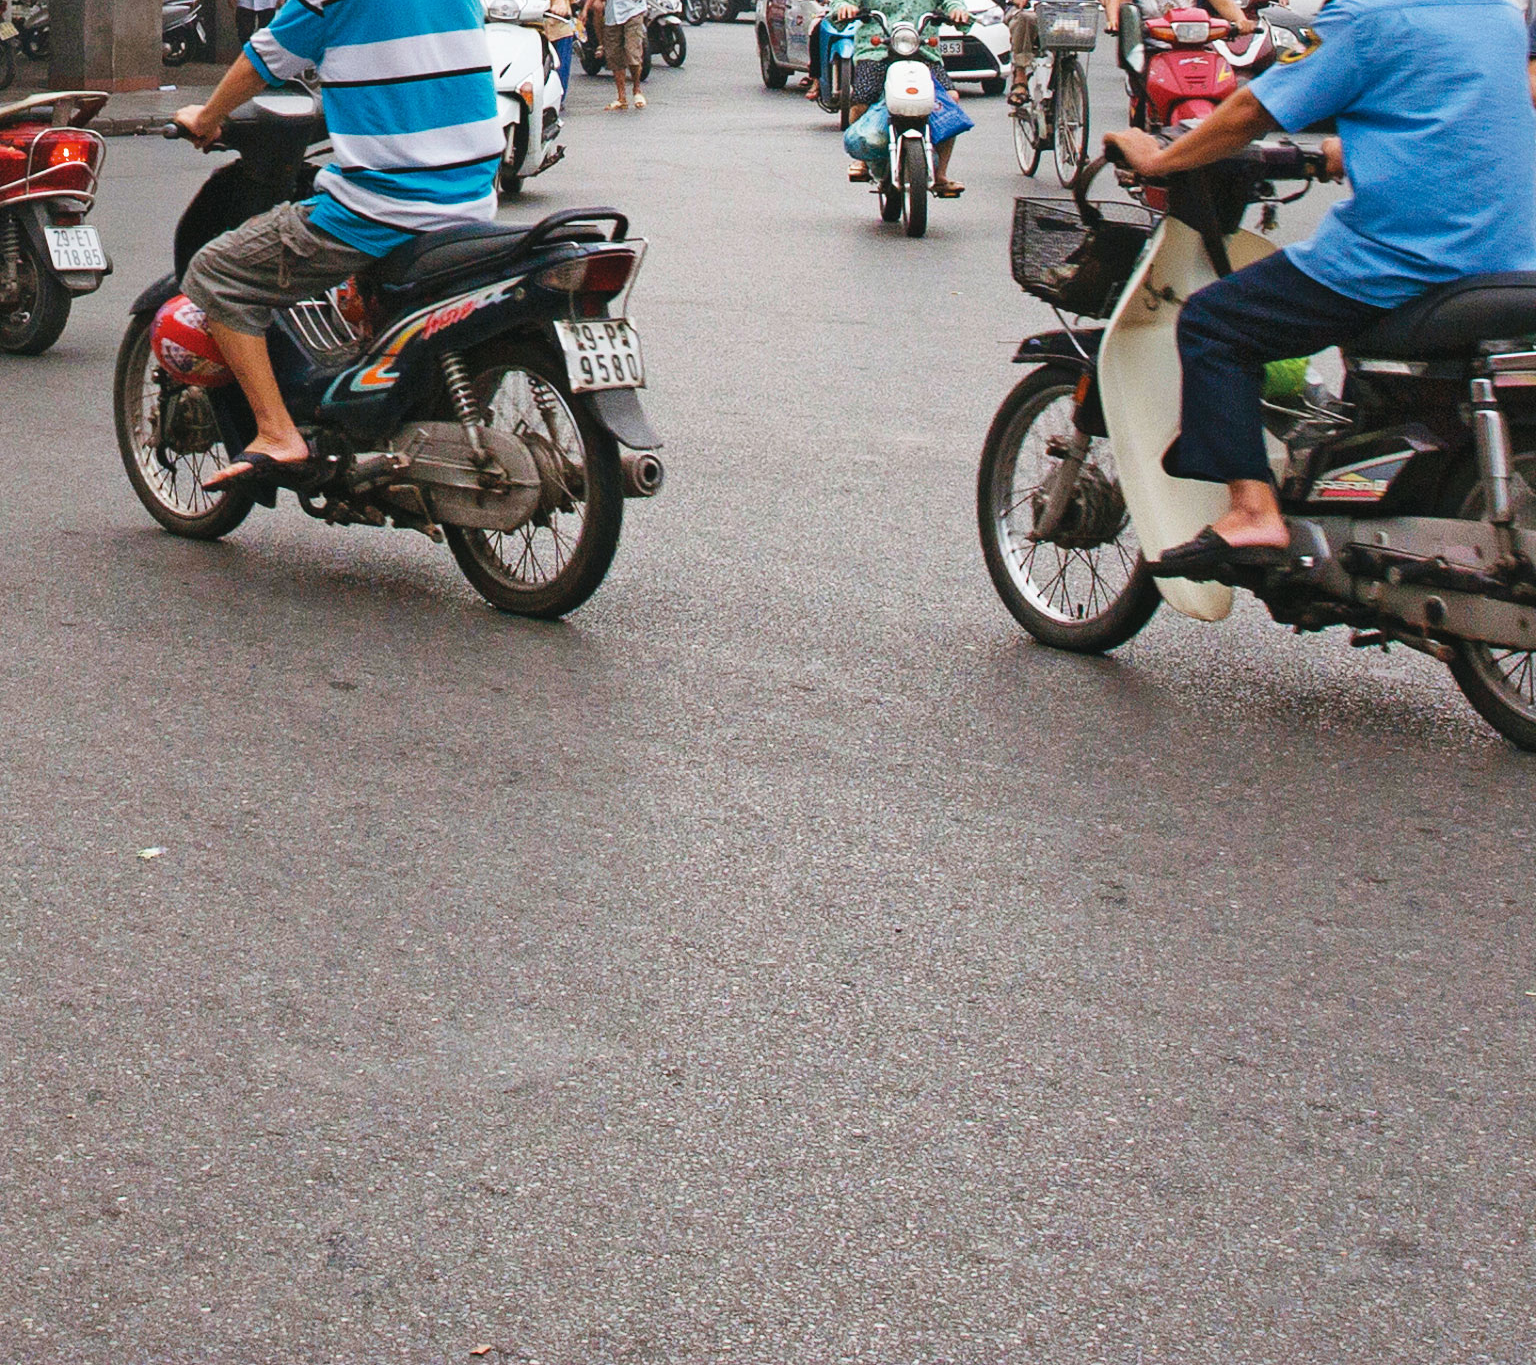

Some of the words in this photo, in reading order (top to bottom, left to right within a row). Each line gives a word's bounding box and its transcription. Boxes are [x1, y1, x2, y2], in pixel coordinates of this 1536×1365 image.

[53, 229, 93, 248] 29-E1
[54, 248, 102, 267] 718.85
[579, 353, 640, 385] 9580
